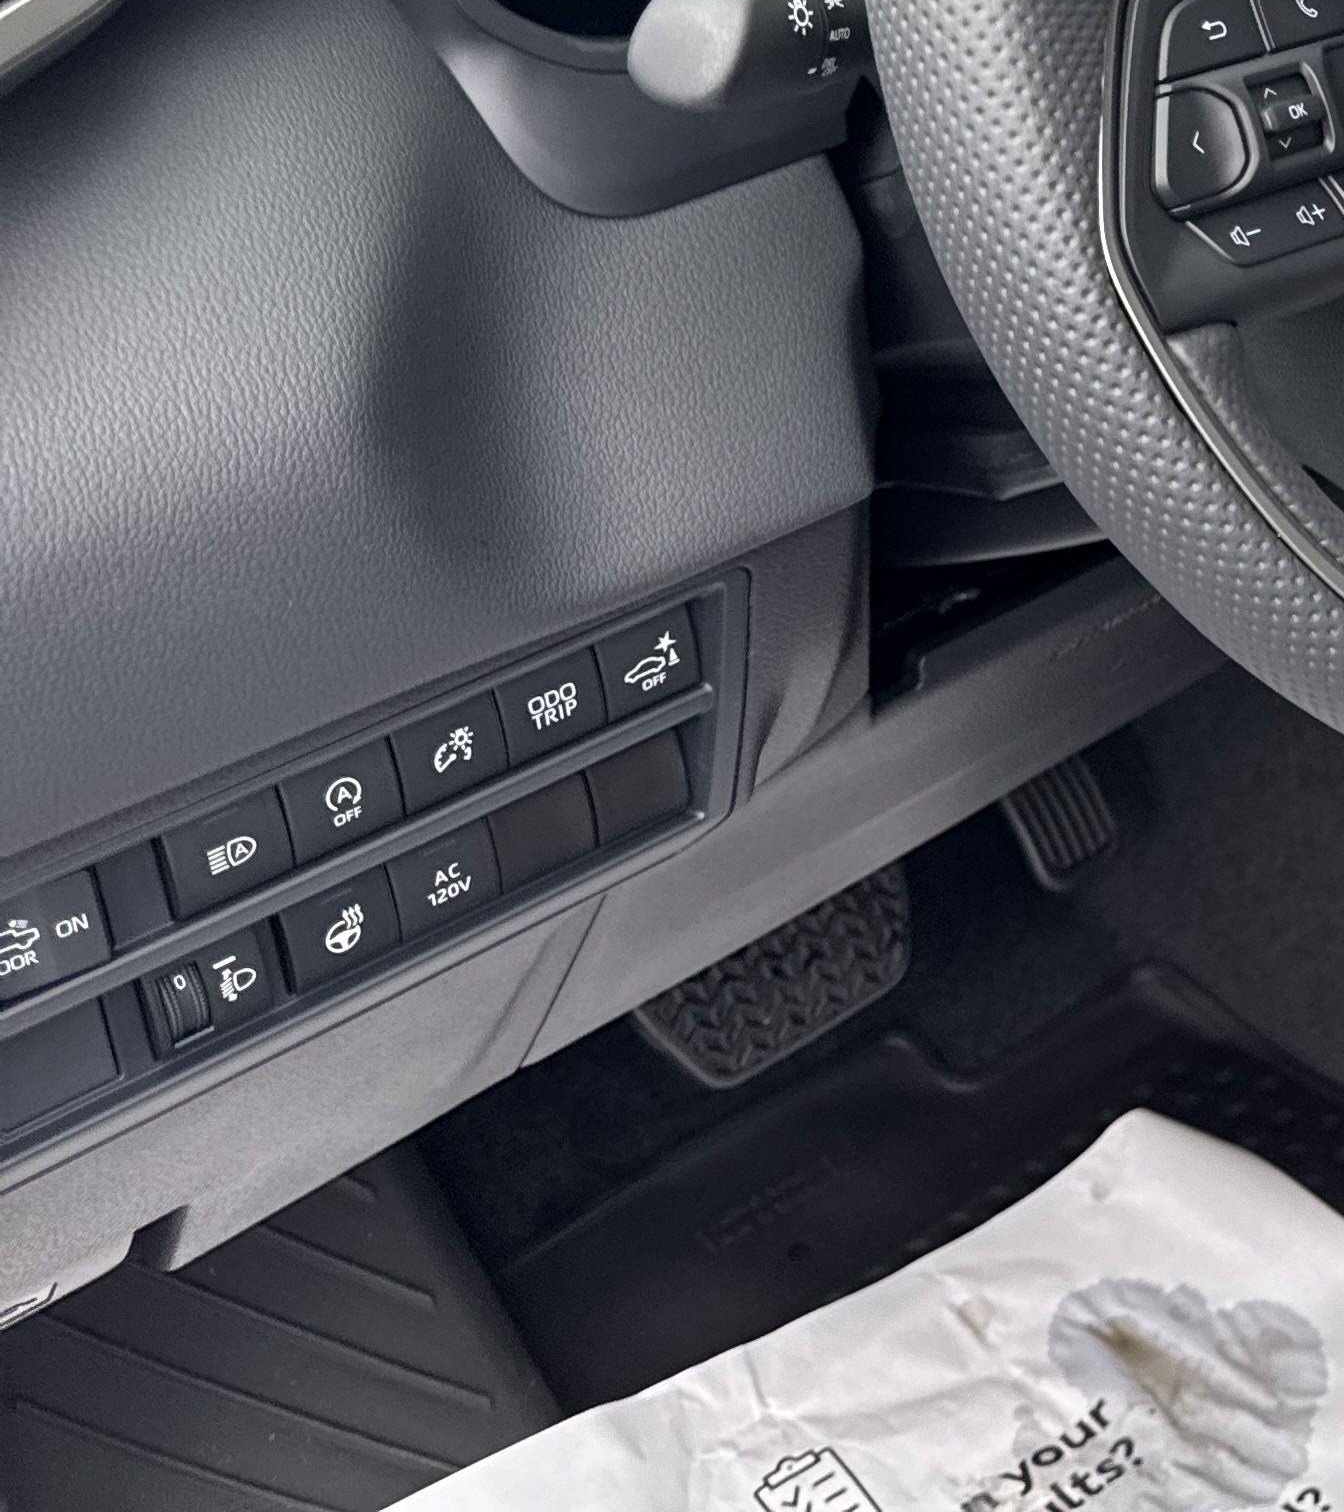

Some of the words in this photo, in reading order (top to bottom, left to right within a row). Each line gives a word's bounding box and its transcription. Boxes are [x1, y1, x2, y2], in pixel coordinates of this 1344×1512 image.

[829, 26, 851, 42] AUTO
[1288, 102, 1308, 120] OK
[641, 671, 668, 692] OFF
[527, 682, 577, 716] ODO
[531, 698, 578, 731] TRIP
[333, 806, 363, 828] OFF
[434, 861, 461, 887] AC
[427, 875, 472, 907] 120V
[55, 913, 89, 938] ON
[174, 974, 187, 990] 0
[1001, 1398, 1112, 1497] your
